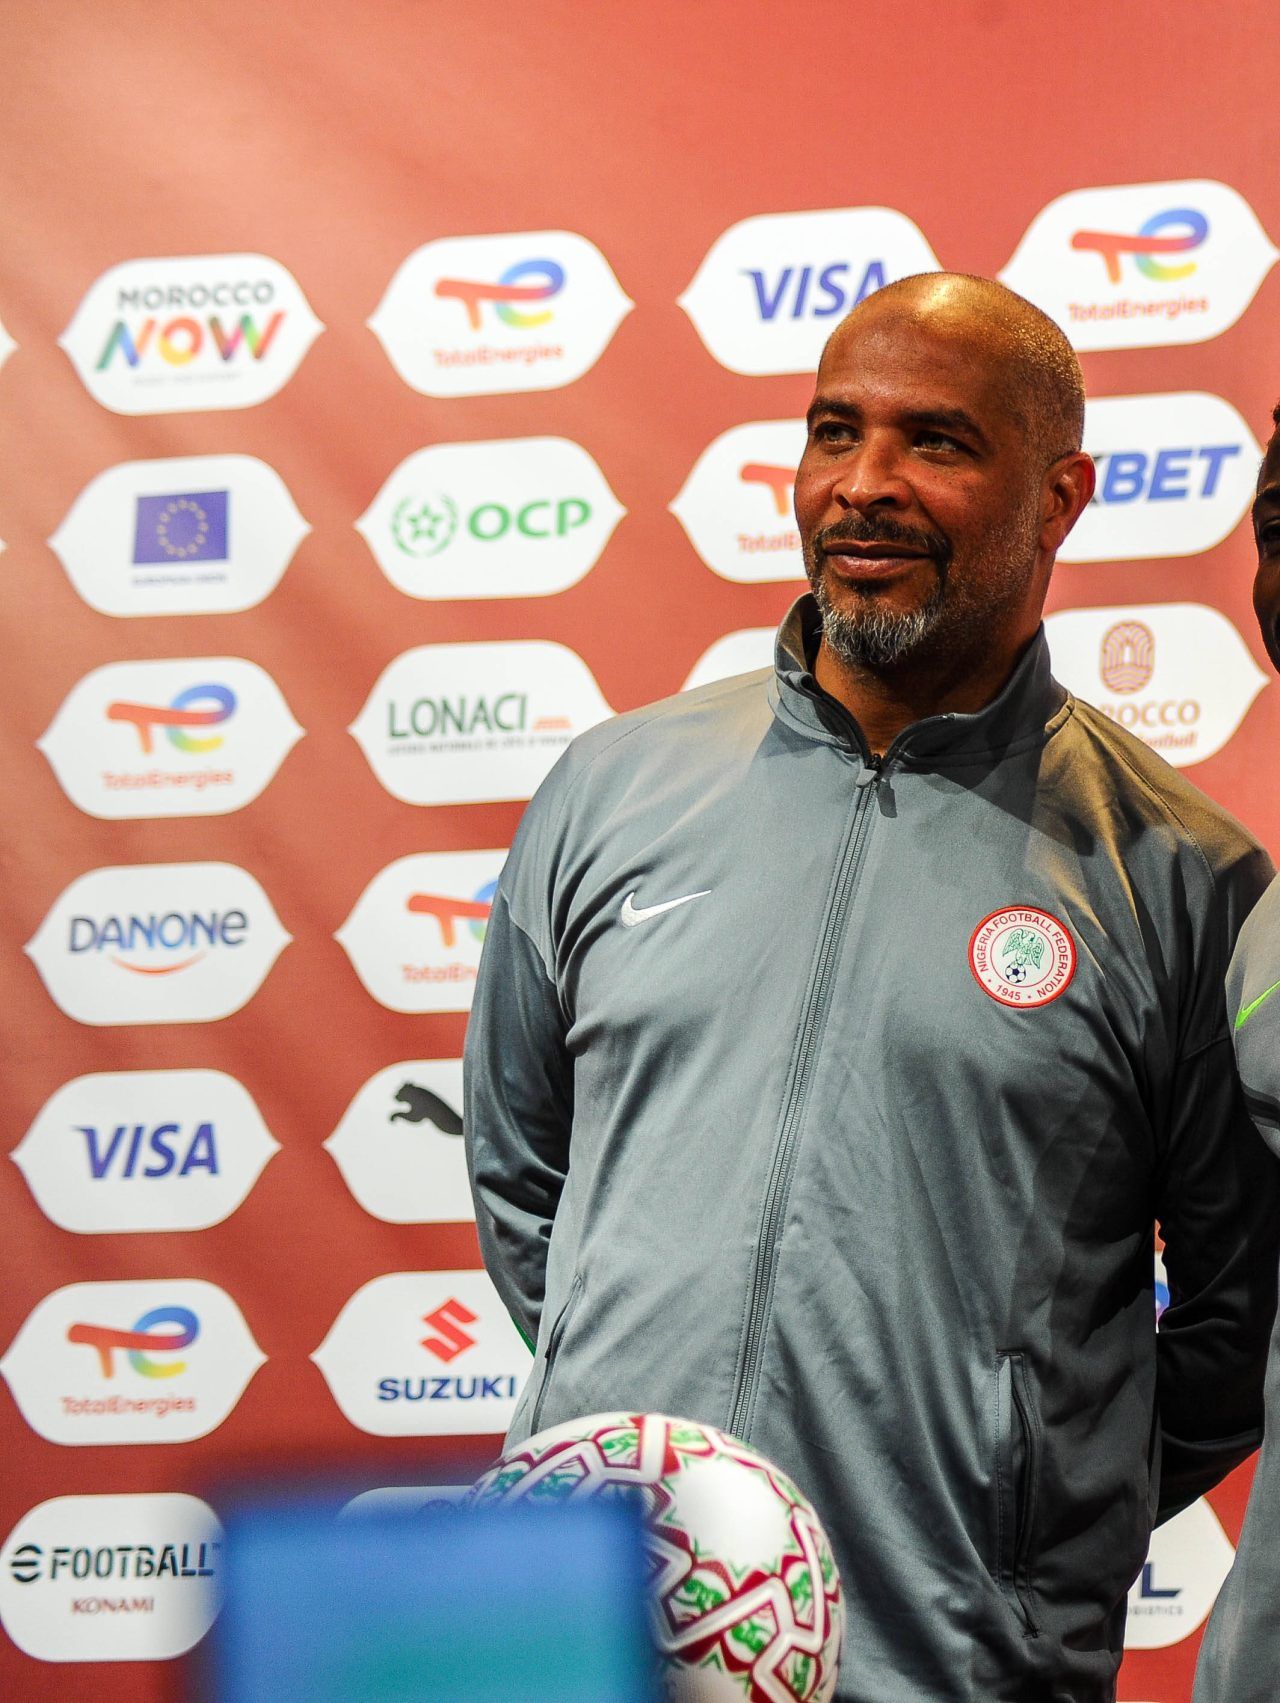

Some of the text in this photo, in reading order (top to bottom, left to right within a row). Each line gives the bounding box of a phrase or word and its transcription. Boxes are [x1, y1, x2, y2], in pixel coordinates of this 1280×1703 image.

[117, 279, 275, 310] MOROCCO
[742, 261, 887, 321] VISA
[1068, 297, 1209, 323] TotalEnergies
[95, 309, 287, 373] NOW
[432, 341, 564, 369] TotalEnergies
[1092, 444, 1241, 505] BET
[467, 498, 592, 542] OCP
[388, 691, 528, 739] LONACI
[101, 769, 235, 792] TotalEnergies
[977, 913, 1068, 998] NIGERIA FOOTBALL FEDERATION
[996, 984, 1021, 1000] 1945
[73, 1122, 220, 1180] VISA
[377, 1376, 516, 1402] SUZUKI
[61, 1394, 196, 1418] TotalEnergies
[71, 1597, 155, 1615] KONAMI
